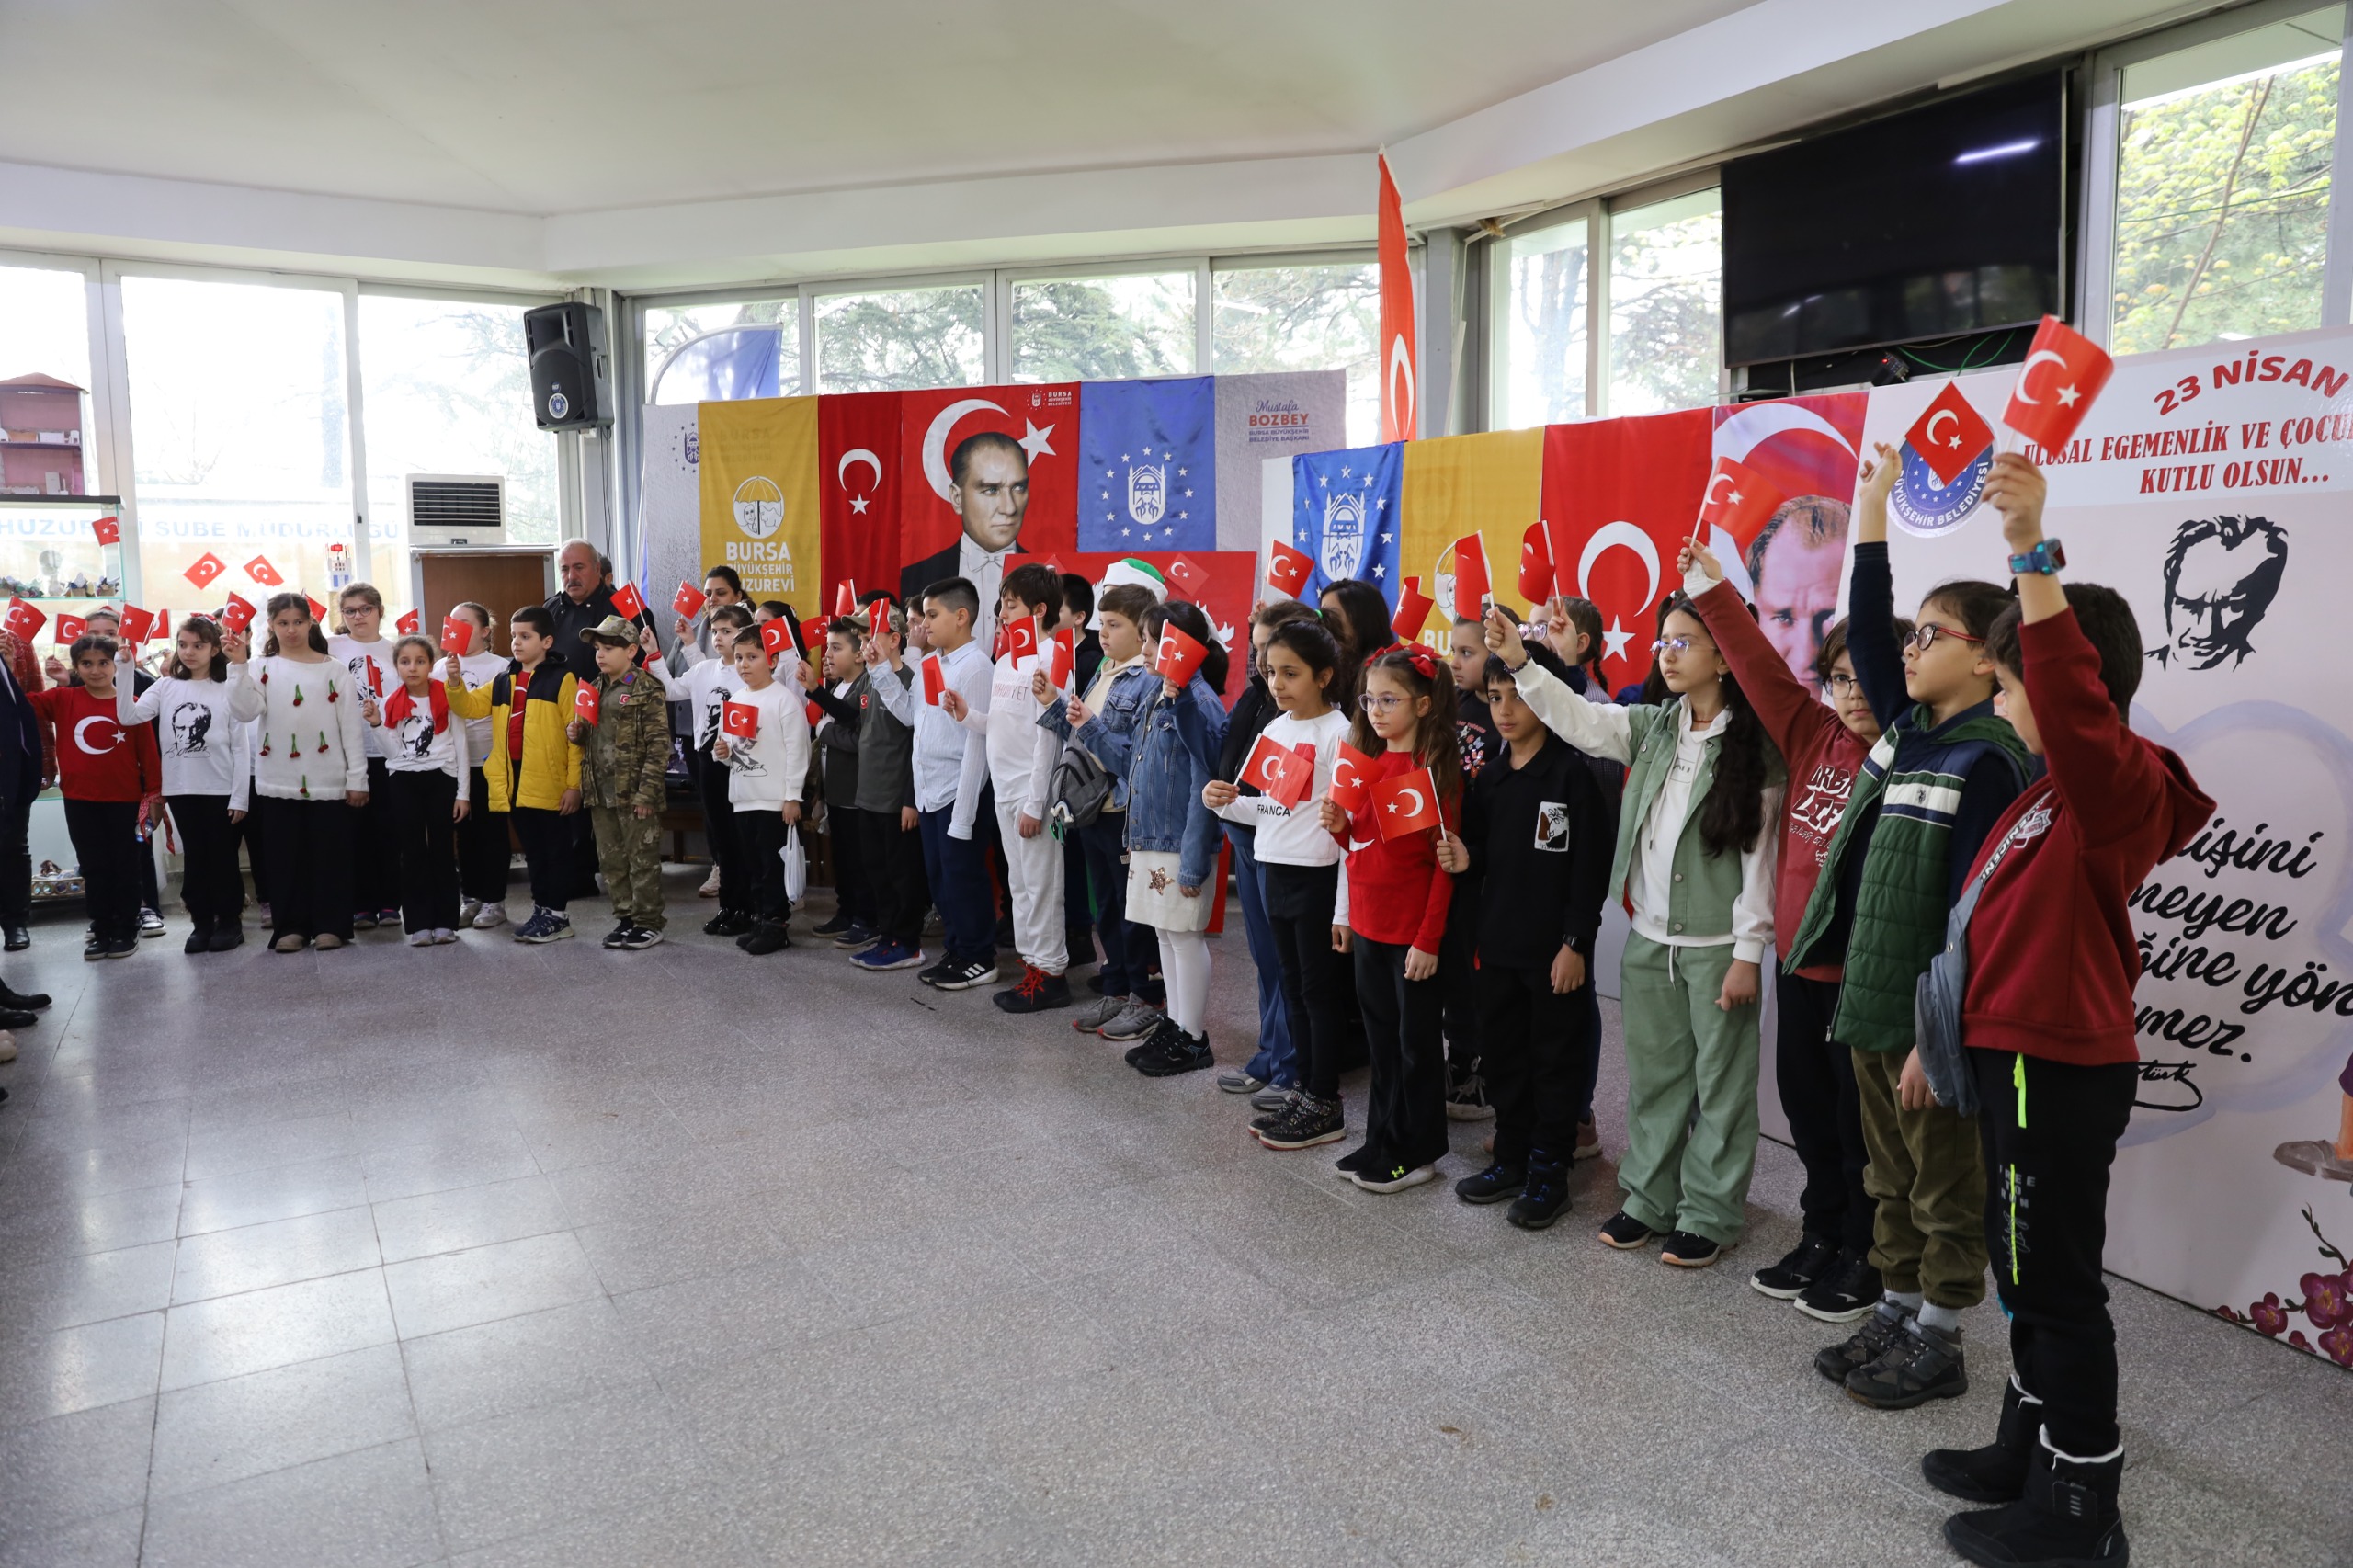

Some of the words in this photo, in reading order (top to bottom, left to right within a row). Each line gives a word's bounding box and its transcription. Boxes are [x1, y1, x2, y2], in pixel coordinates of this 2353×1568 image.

[2154, 375, 2200, 416] 23
[2213, 349, 2349, 398] NİSAN
[1249, 413, 1309, 426] BOZBEY
[1256, 399, 1299, 415] Mustafa
[2099, 420, 2231, 461] EGEMENLİK
[2242, 421, 2271, 450] VE
[2280, 413, 2353, 450] ÇOCU
[1938, 461, 1989, 526] BELEDİYESİ
[2140, 463, 2216, 494] KUTLU
[726, 541, 791, 561] BURSA
[2176, 817, 2324, 879] işini
